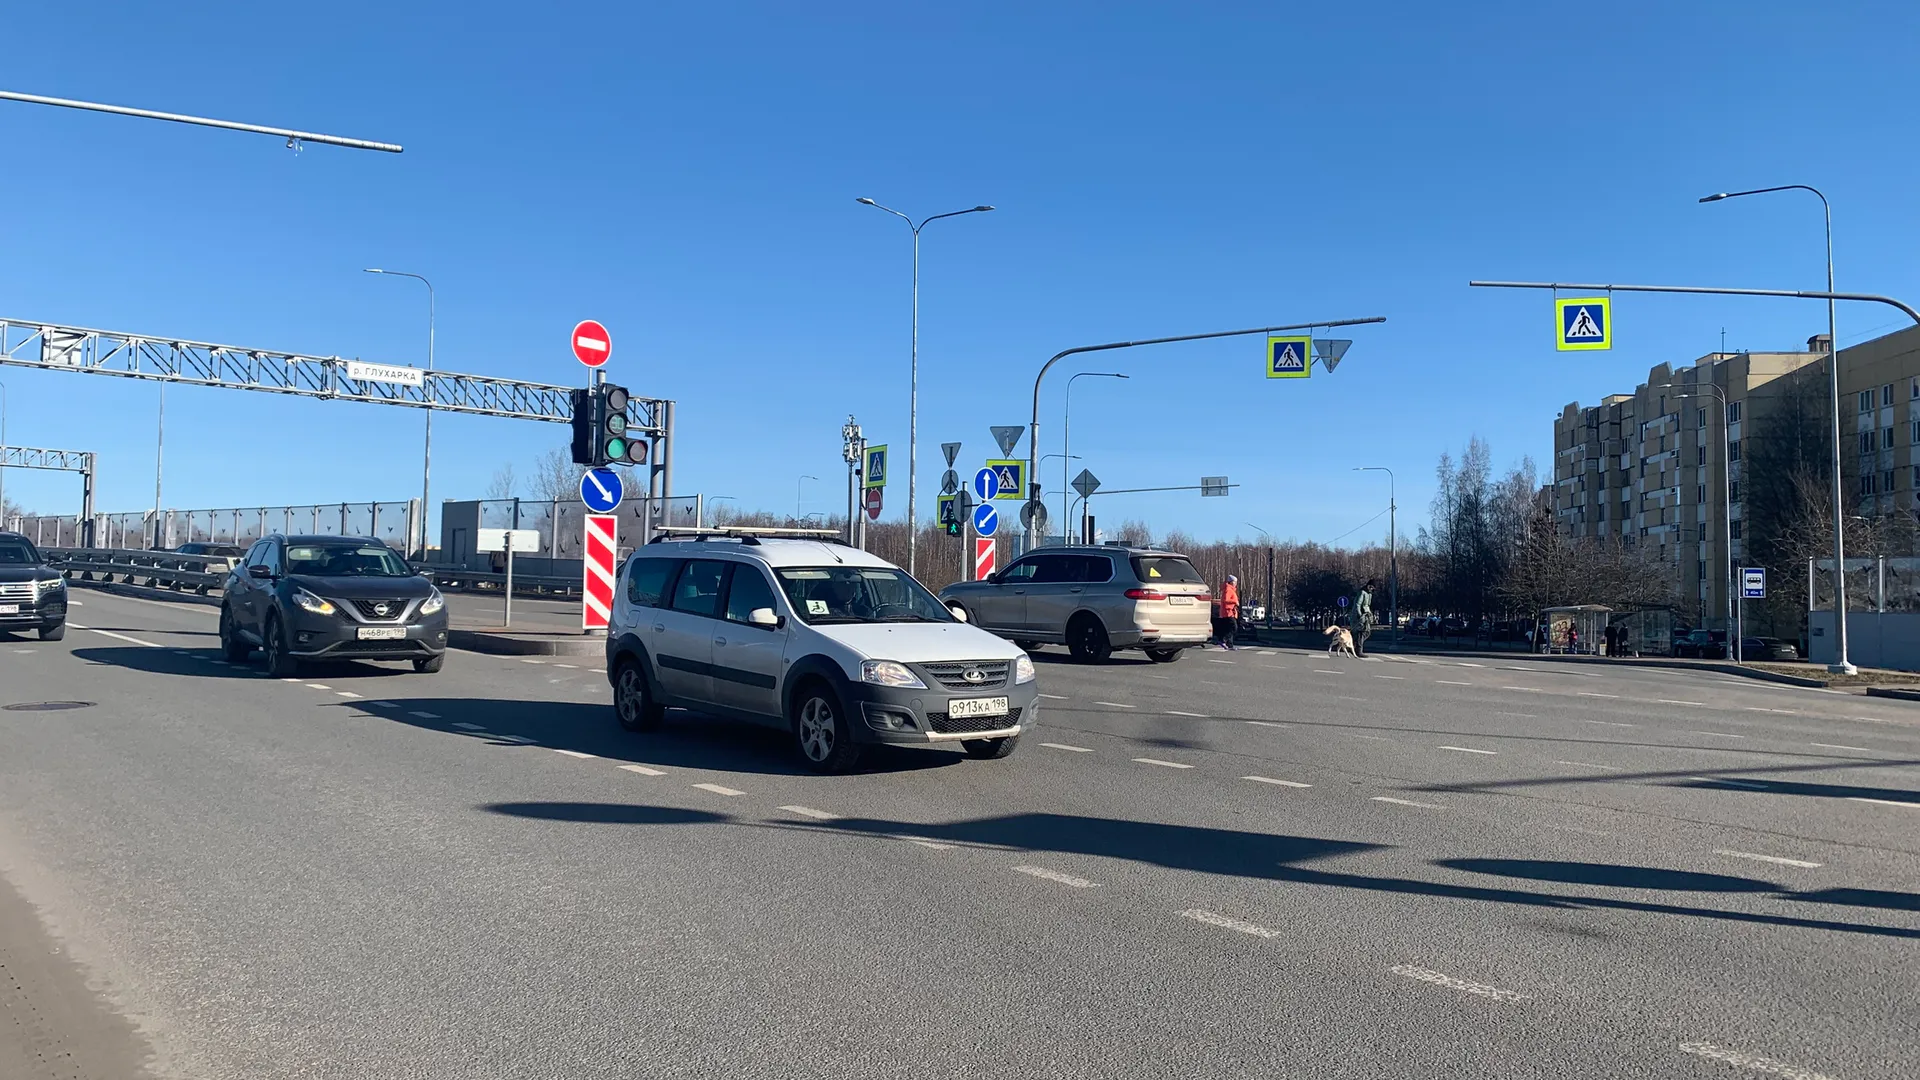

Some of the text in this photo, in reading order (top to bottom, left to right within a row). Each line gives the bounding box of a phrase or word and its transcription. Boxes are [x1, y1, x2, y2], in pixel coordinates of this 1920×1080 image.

[353, 367, 416, 381] р. ГЛУХАРКА
[952, 698, 1006, 714] О913КА 198
